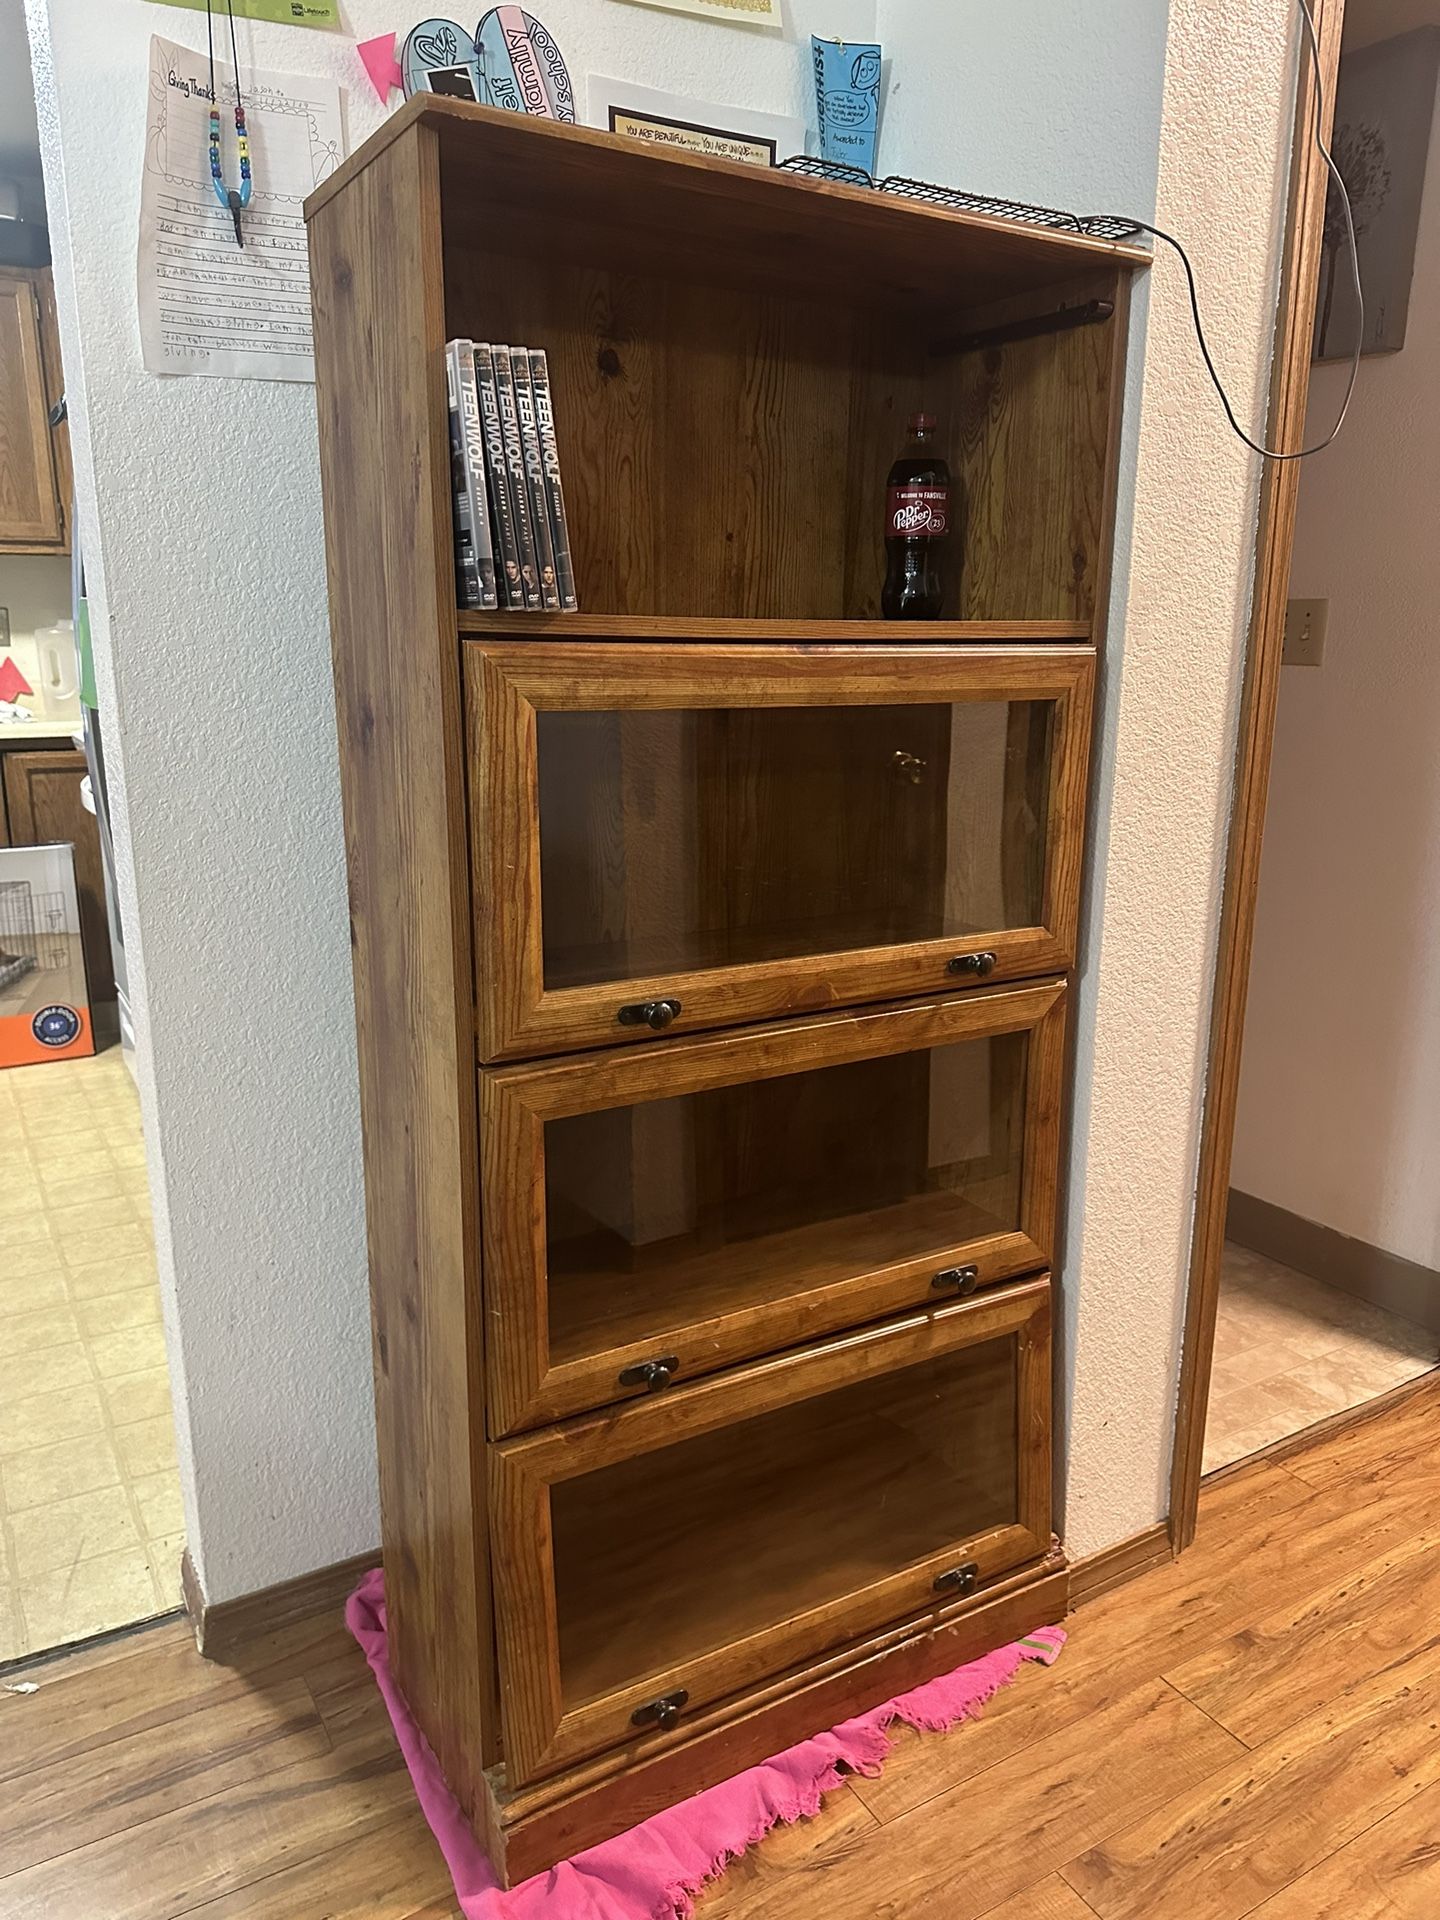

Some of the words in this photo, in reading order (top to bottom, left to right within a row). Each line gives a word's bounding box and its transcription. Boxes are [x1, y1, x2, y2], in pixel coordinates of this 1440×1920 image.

[529, 22, 572, 104] school
[168, 70, 190, 98] Giving
[189, 78, 216, 101] Thanks
[626, 124, 638, 136] YOU
[638, 127, 654, 139] ARE
[924, 491, 947, 500] FANSVILLE
[896, 509, 929, 530] Pepper
[906, 505, 920, 518] Dr
